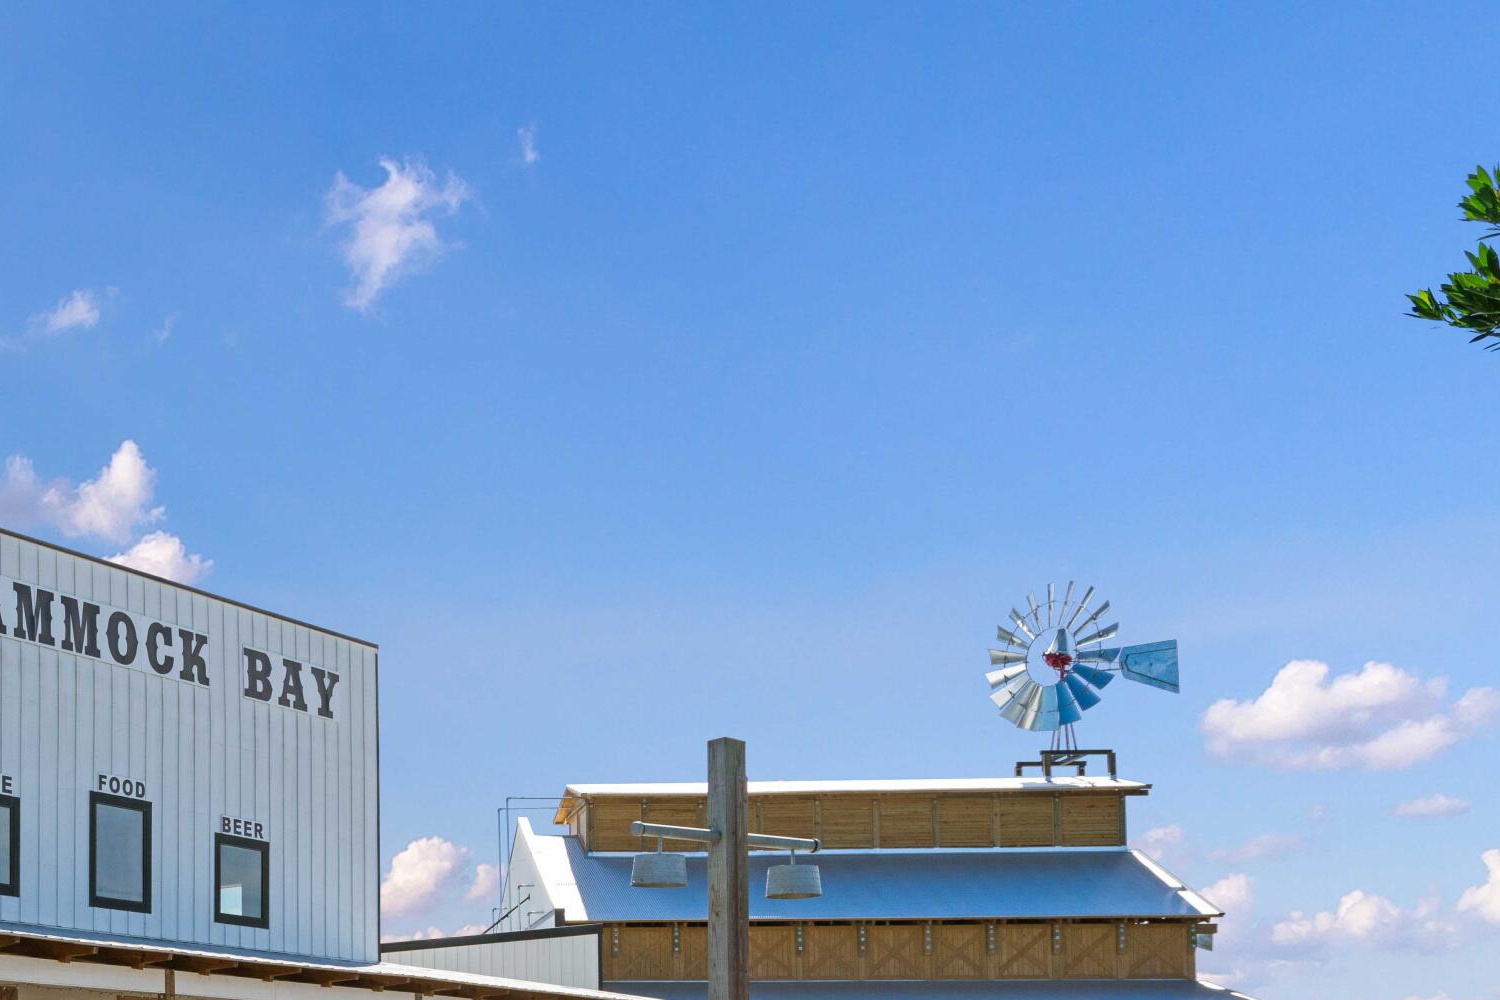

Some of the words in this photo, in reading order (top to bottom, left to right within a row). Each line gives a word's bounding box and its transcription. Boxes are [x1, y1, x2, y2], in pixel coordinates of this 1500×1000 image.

[243, 646, 340, 719] BAY
[98, 774, 147, 799] FOOD
[221, 816, 264, 840] BEER
